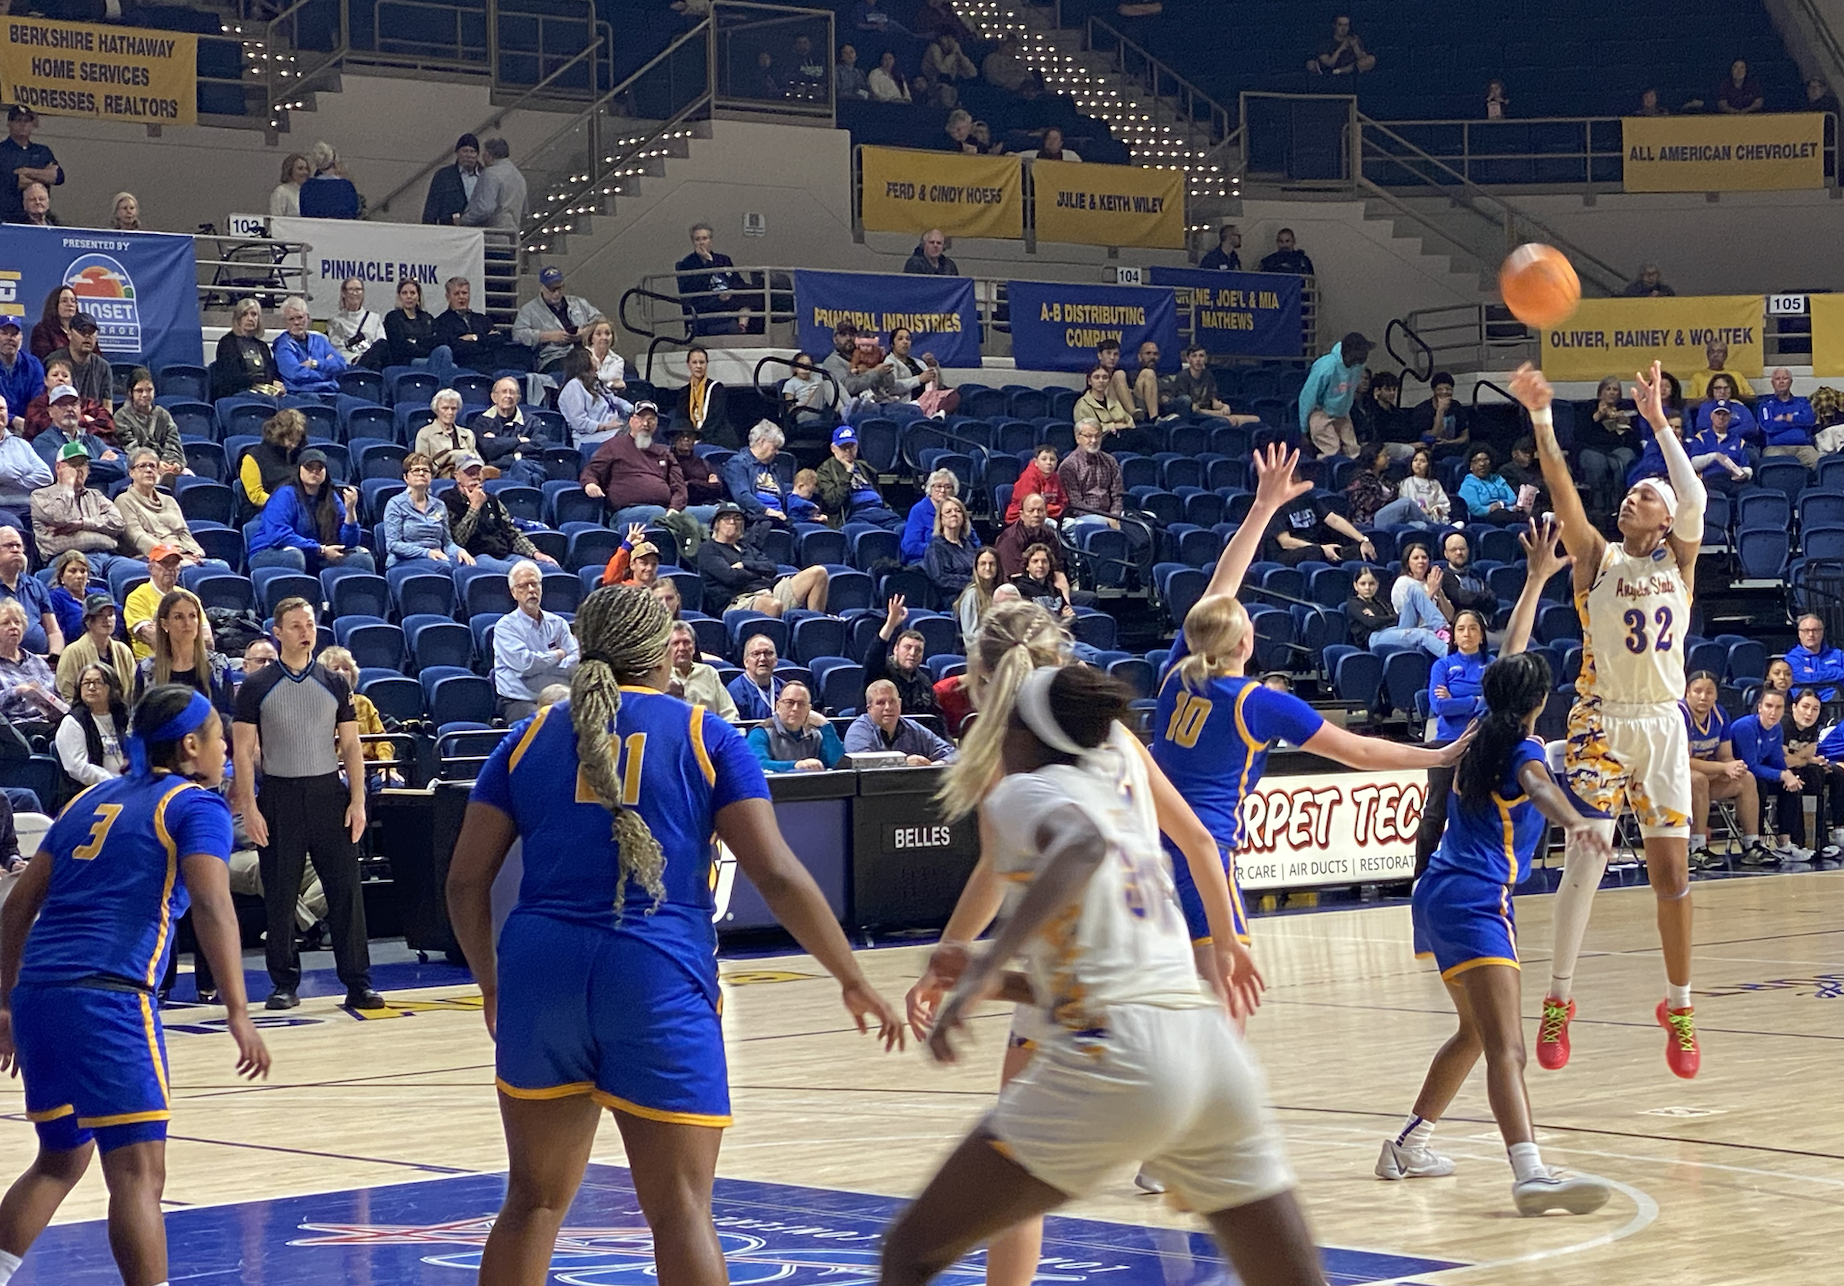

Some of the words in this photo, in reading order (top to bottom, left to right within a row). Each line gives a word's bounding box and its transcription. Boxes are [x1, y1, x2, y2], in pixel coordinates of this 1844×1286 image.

[10, 24, 94, 51] BERKSHIRE
[99, 34, 175, 58] HATHAWAY
[32, 57, 75, 79] HOME
[80, 62, 149, 86] SERVICES
[104, 95, 178, 118] REALTORS
[1629, 146, 1655, 161] ALL
[1659, 145, 1731, 161] AMERICAN
[1736, 142, 1818, 160] CHEVROLET
[886, 181, 915, 200] FERD
[919, 184, 926, 201] &
[930, 185, 963, 203] CINDY
[1057, 191, 1085, 209] JULIE
[1088, 194, 1096, 210] &
[1099, 194, 1130, 212] KEITH
[1132, 196, 1163, 213] WILEY
[63, 238, 115, 250] PRESENTED
[117, 241, 130, 251] BY
[321, 259, 394, 282] PINNACLE
[399, 263, 438, 284] BANK
[1119, 270, 1139, 283] 104
[77, 302, 133, 320] UNSET
[1248, 291, 1256, 309] &
[1259, 291, 1279, 309] MIA
[1773, 298, 1801, 310] 105
[883, 311, 962, 334] INDUSTRIES
[1040, 302, 1061, 322] A-B
[1064, 304, 1145, 325] DISTRIBUTING
[1202, 310, 1254, 331] MATHEWS
[1551, 330, 1609, 351] OLIVER,
[1614, 329, 1671, 348] RAINEY
[1675, 329, 1685, 346] &
[1623, 605, 1673, 655] 32
[1165, 691, 1213, 749] 10
[1240, 786, 1343, 854] RPET
[1351, 782, 1428, 847] TEC
[72, 803, 124, 861] 3
[894, 826, 951, 849] BELLES
[1247, 864, 1277, 880] CARE
[1289, 862, 1308, 877] AIR
[1311, 859, 1348, 875] DUCTS
[1360, 855, 1417, 872] RESTORAT
